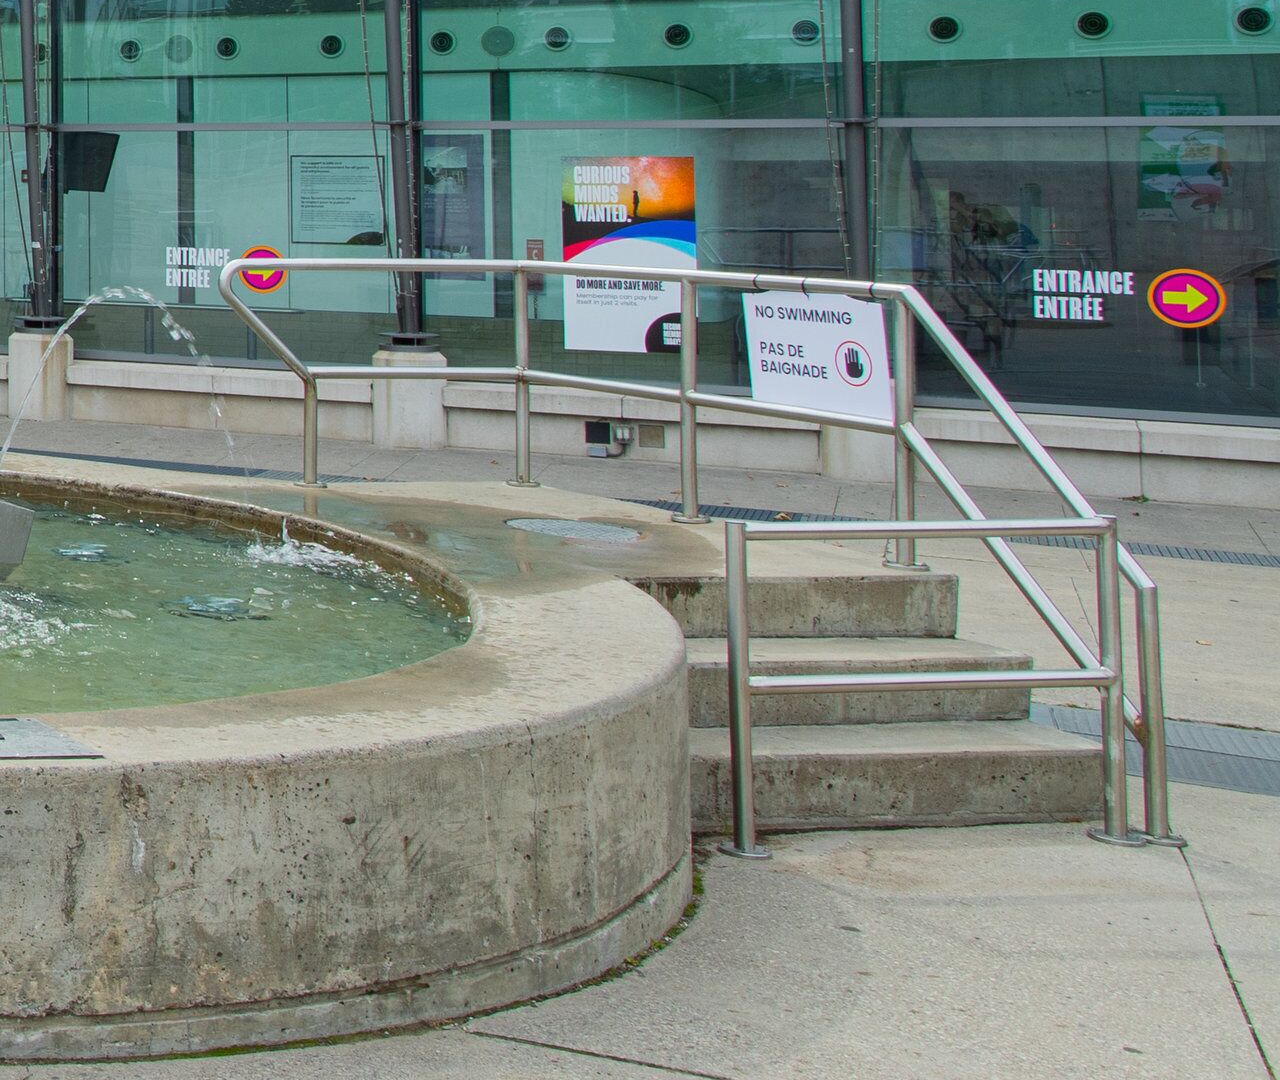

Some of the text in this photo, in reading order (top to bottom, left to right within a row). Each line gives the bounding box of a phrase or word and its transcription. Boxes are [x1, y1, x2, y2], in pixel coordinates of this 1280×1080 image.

[573, 165, 630, 184] CURIOUS
[573, 185, 618, 203] MINDS
[573, 204, 632, 222] WANTED.
[166, 247, 230, 267] ENTRANCE
[166, 267, 210, 288] ENTRÉE
[576, 279, 665, 291] DO MORE AND SAVE MORE.
[1033, 269, 1134, 295] ENTRANCE
[755, 305, 852, 325] NO SWIMMING
[1033, 295, 1104, 320] ENTRÉE
[760, 341, 804, 358] PAS DE
[760, 359, 828, 379] BAIGNADE
